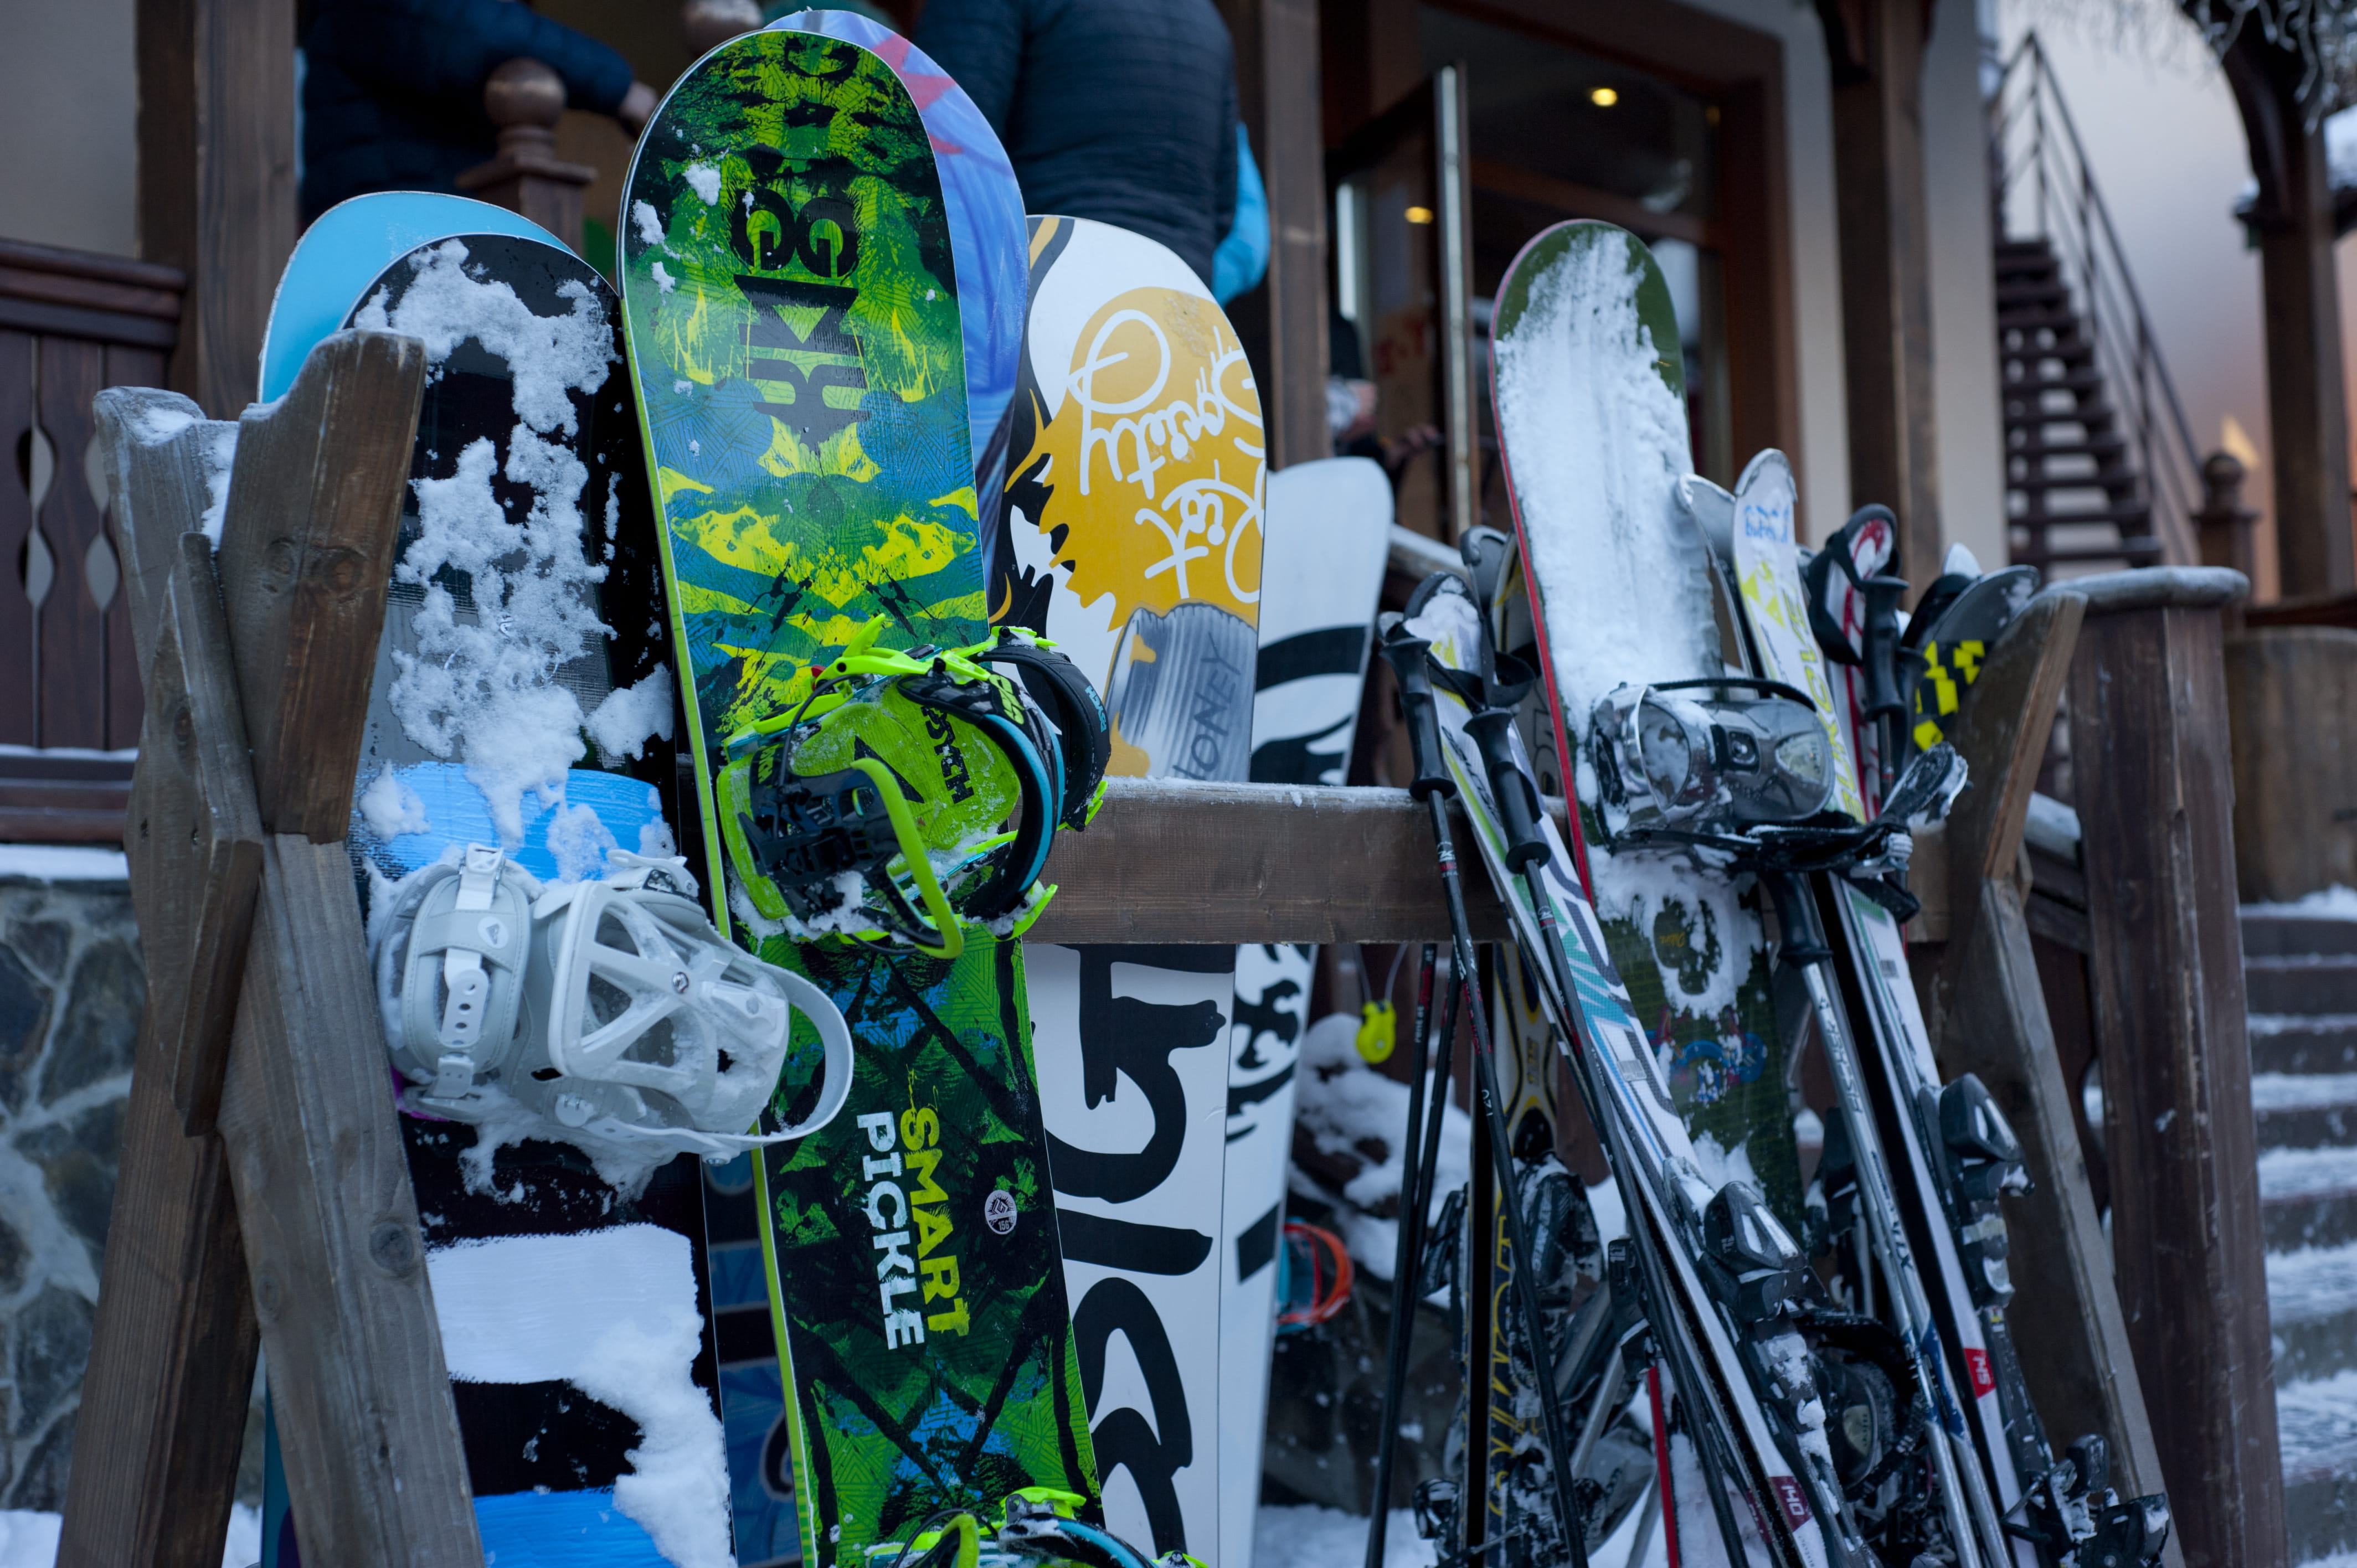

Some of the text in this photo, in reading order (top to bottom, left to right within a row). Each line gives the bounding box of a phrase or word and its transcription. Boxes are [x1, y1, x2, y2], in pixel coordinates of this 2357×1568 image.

[1068, 309, 1265, 499] Society
[1134, 460, 1265, 604] Riot
[1785, 582, 1866, 824] BUKOVE
[857, 1111, 925, 1350] PICKLE
[899, 1107, 970, 1337] SMART
[998, 1220, 1010, 1231] 156
[1780, 1485, 1805, 1516] 140
